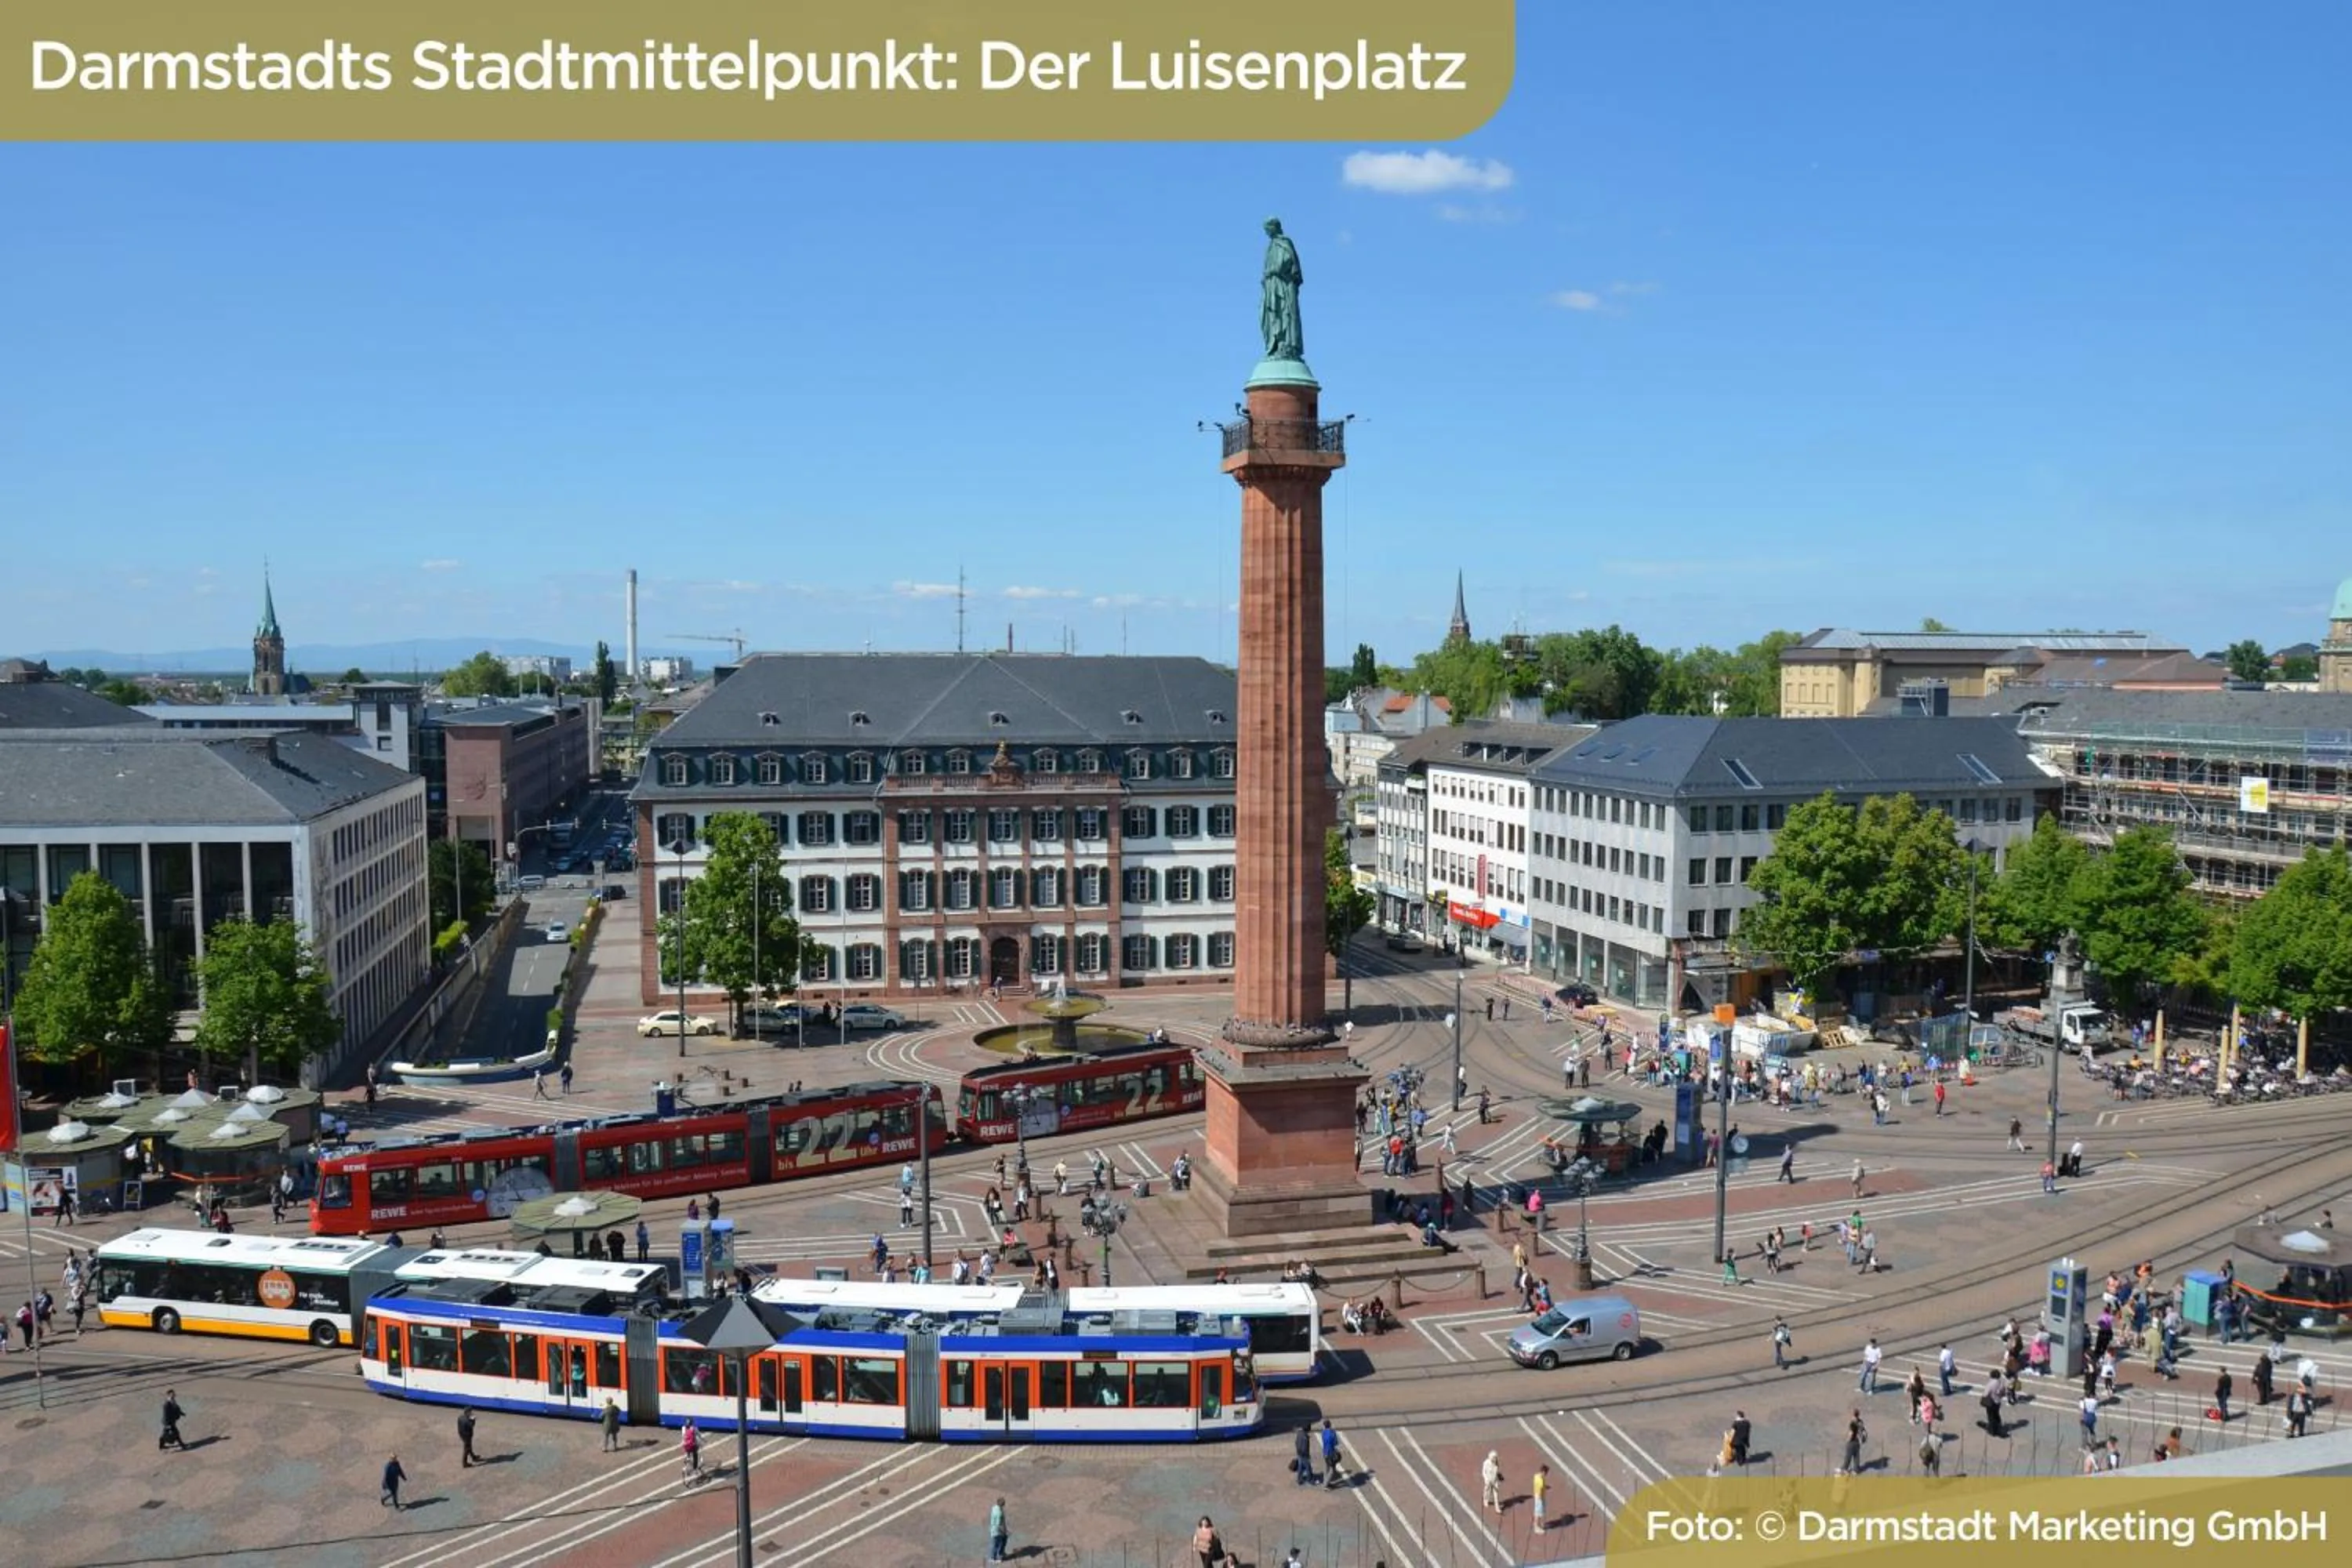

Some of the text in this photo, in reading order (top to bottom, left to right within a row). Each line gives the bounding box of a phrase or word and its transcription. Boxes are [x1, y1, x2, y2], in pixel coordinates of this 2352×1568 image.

[1125, 1076, 1163, 1116] 22
[1182, 1090, 1203, 1104] REWE
[980, 1123, 1015, 1136] REWE
[778, 1158, 793, 1171] bis
[790, 1111, 857, 1167] 22
[882, 1138, 916, 1153] REWE
[343, 1163, 367, 1172] REWE
[371, 1206, 407, 1220] REWE
